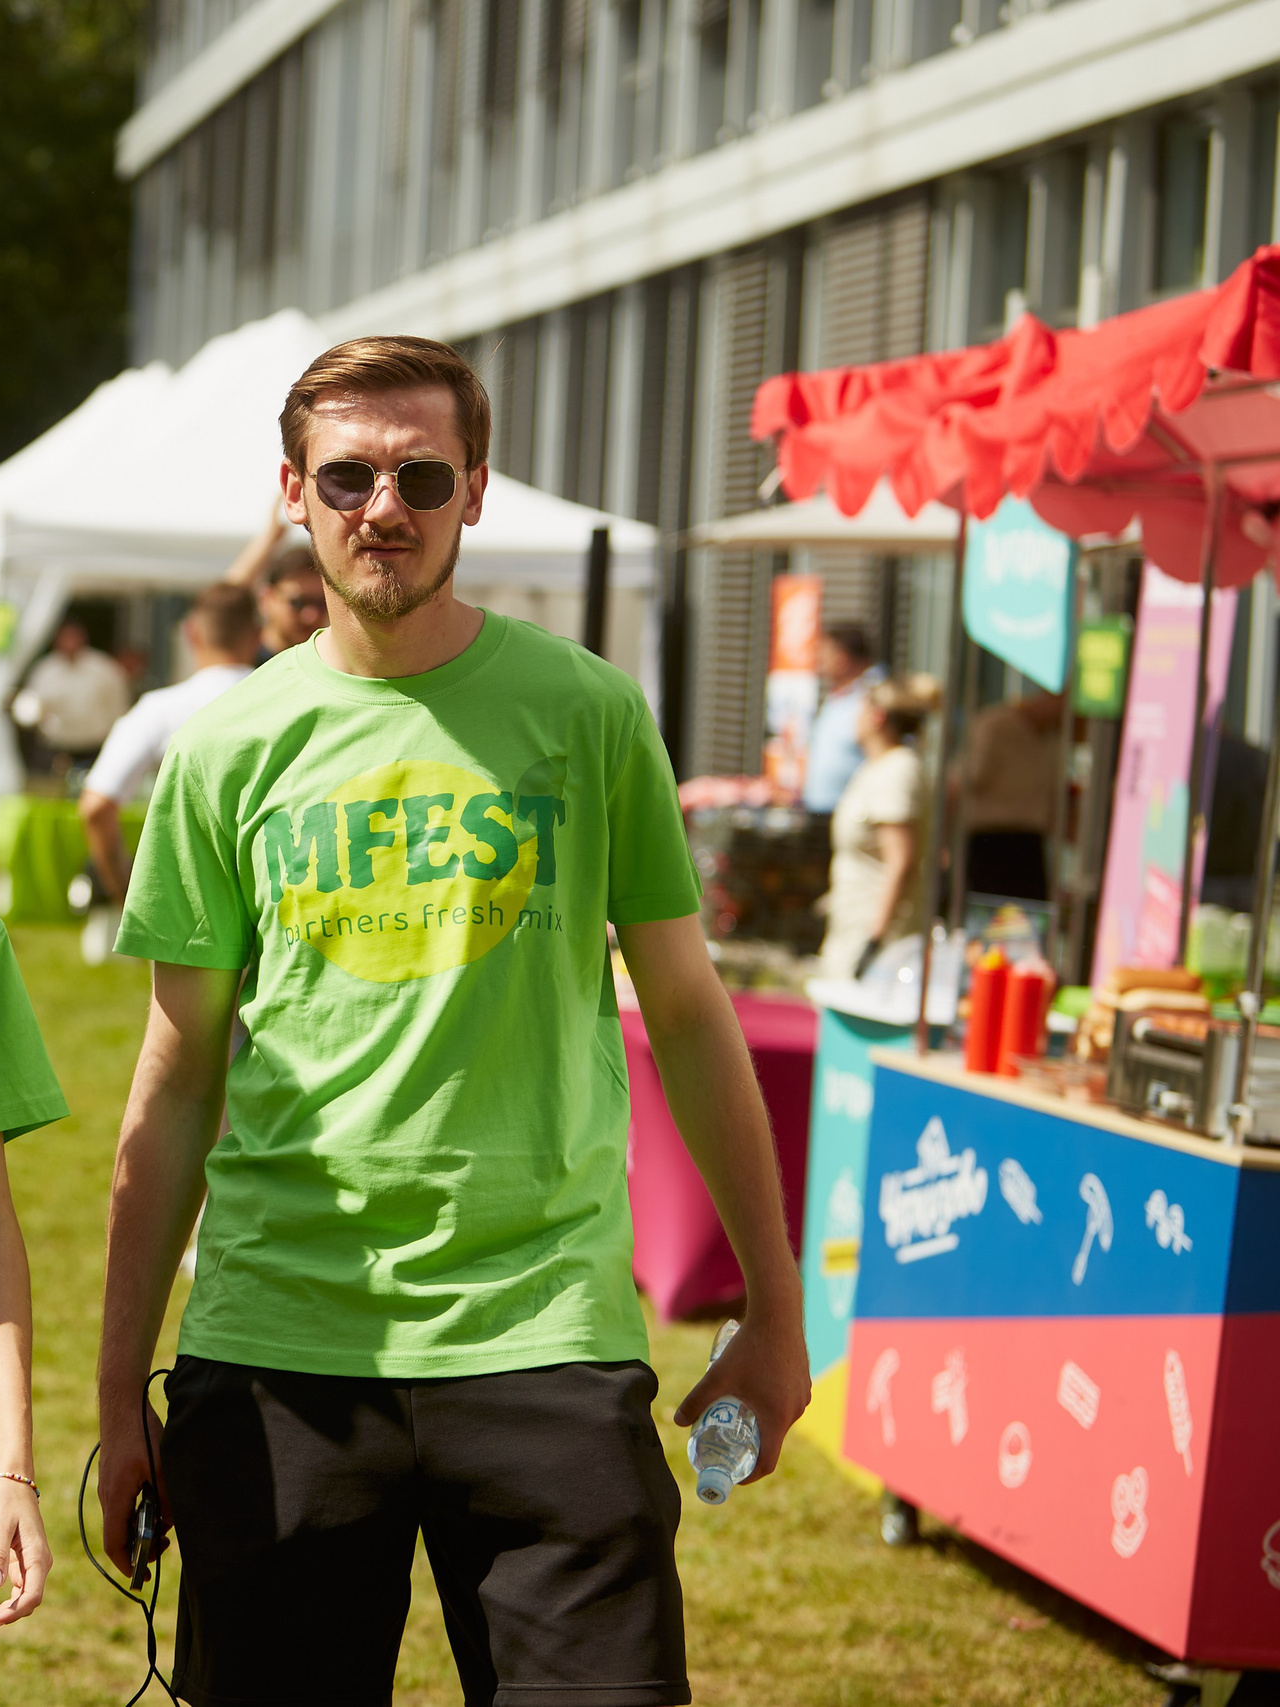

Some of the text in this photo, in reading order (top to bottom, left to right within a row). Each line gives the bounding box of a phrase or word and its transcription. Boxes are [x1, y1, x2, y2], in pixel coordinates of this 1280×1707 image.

[263, 790, 566, 904] MFEST
[422, 900, 504, 930] fresh
[518, 904, 563, 932] mix
